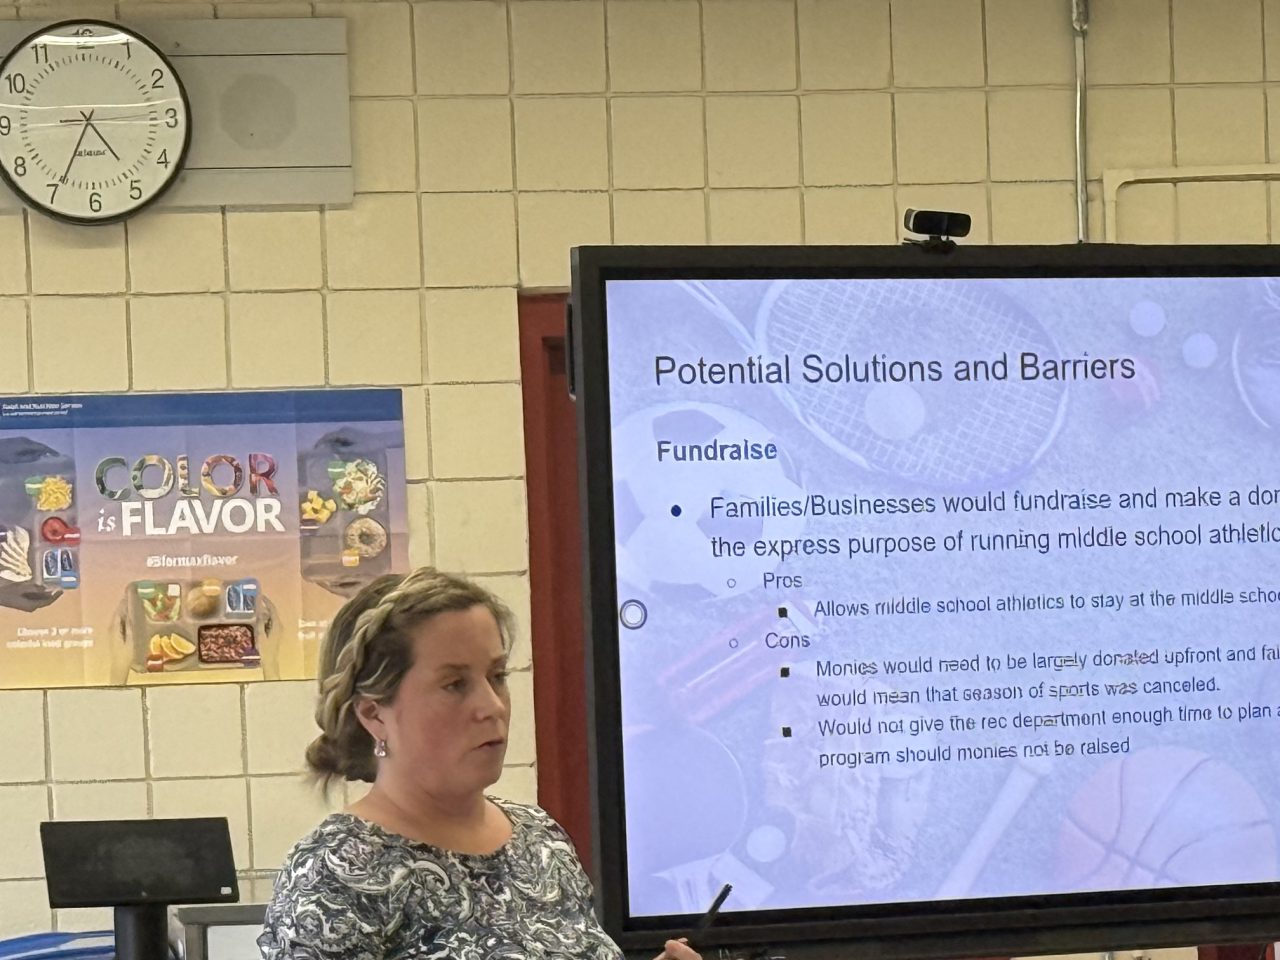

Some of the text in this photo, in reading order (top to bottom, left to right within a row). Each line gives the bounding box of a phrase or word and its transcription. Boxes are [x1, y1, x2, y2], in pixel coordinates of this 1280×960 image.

[31, 44, 49, 64] 11
[5, 73, 26, 94] 10
[151, 69, 165, 89] 2
[0, 116, 12, 136] 9
[165, 108, 178, 128] 3
[14, 156, 27, 177] 8
[157, 149, 171, 169] 4
[47, 183, 60, 205] 7
[130, 180, 142, 200] 5
[89, 192, 102, 212] 6
[655, 349, 1136, 387] Potential Solutions and Barriers
[656, 438, 778, 463] Fundraise
[95, 453, 281, 500] COLOR
[710, 493, 937, 520] Families/Businesses
[941, 490, 1006, 514] would
[1013, 488, 1113, 513] fundraise
[1118, 485, 1158, 510] and
[1165, 485, 1223, 509] make
[1228, 490, 1241, 507] a
[98, 497, 286, 537] is FLAVOR
[710, 536, 746, 558] the
[753, 538, 841, 562] express
[848, 535, 937, 560] purpose
[943, 529, 964, 552] of
[970, 528, 1050, 555] running
[1057, 525, 1128, 550] middle
[1134, 523, 1202, 547] school
[763, 571, 803, 590] Pros
[813, 599, 870, 619] Allows
[874, 595, 932, 616] middle
[936, 595, 992, 615] school
[995, 593, 1065, 612] athletics
[1069, 593, 1086, 610] to
[1090, 593, 1125, 612] stay
[1128, 591, 1145, 608] at
[1149, 588, 1177, 607] the
[1180, 588, 1235, 607] middle
[764, 631, 811, 650] Cons
[816, 658, 879, 677] Monies
[882, 655, 933, 675] would
[938, 653, 980, 673] need
[985, 655, 1002, 674] to
[1006, 653, 1028, 670] be
[1164, 646, 1222, 669] upfront
[1226, 646, 1256, 662] and
[815, 675, 1222, 707] would mean that season of sports was canceled.
[817, 715, 872, 737] Would
[877, 719, 904, 735] not
[909, 715, 945, 737] give
[949, 714, 977, 732] the
[981, 716, 1008, 731] rec
[1012, 709, 1107, 734] department
[1111, 705, 1175, 727] enough
[1178, 703, 1213, 722] time
[1217, 704, 1233, 720] to
[1237, 701, 1272, 723] plan
[818, 735, 1130, 770] program should monies not be raised
